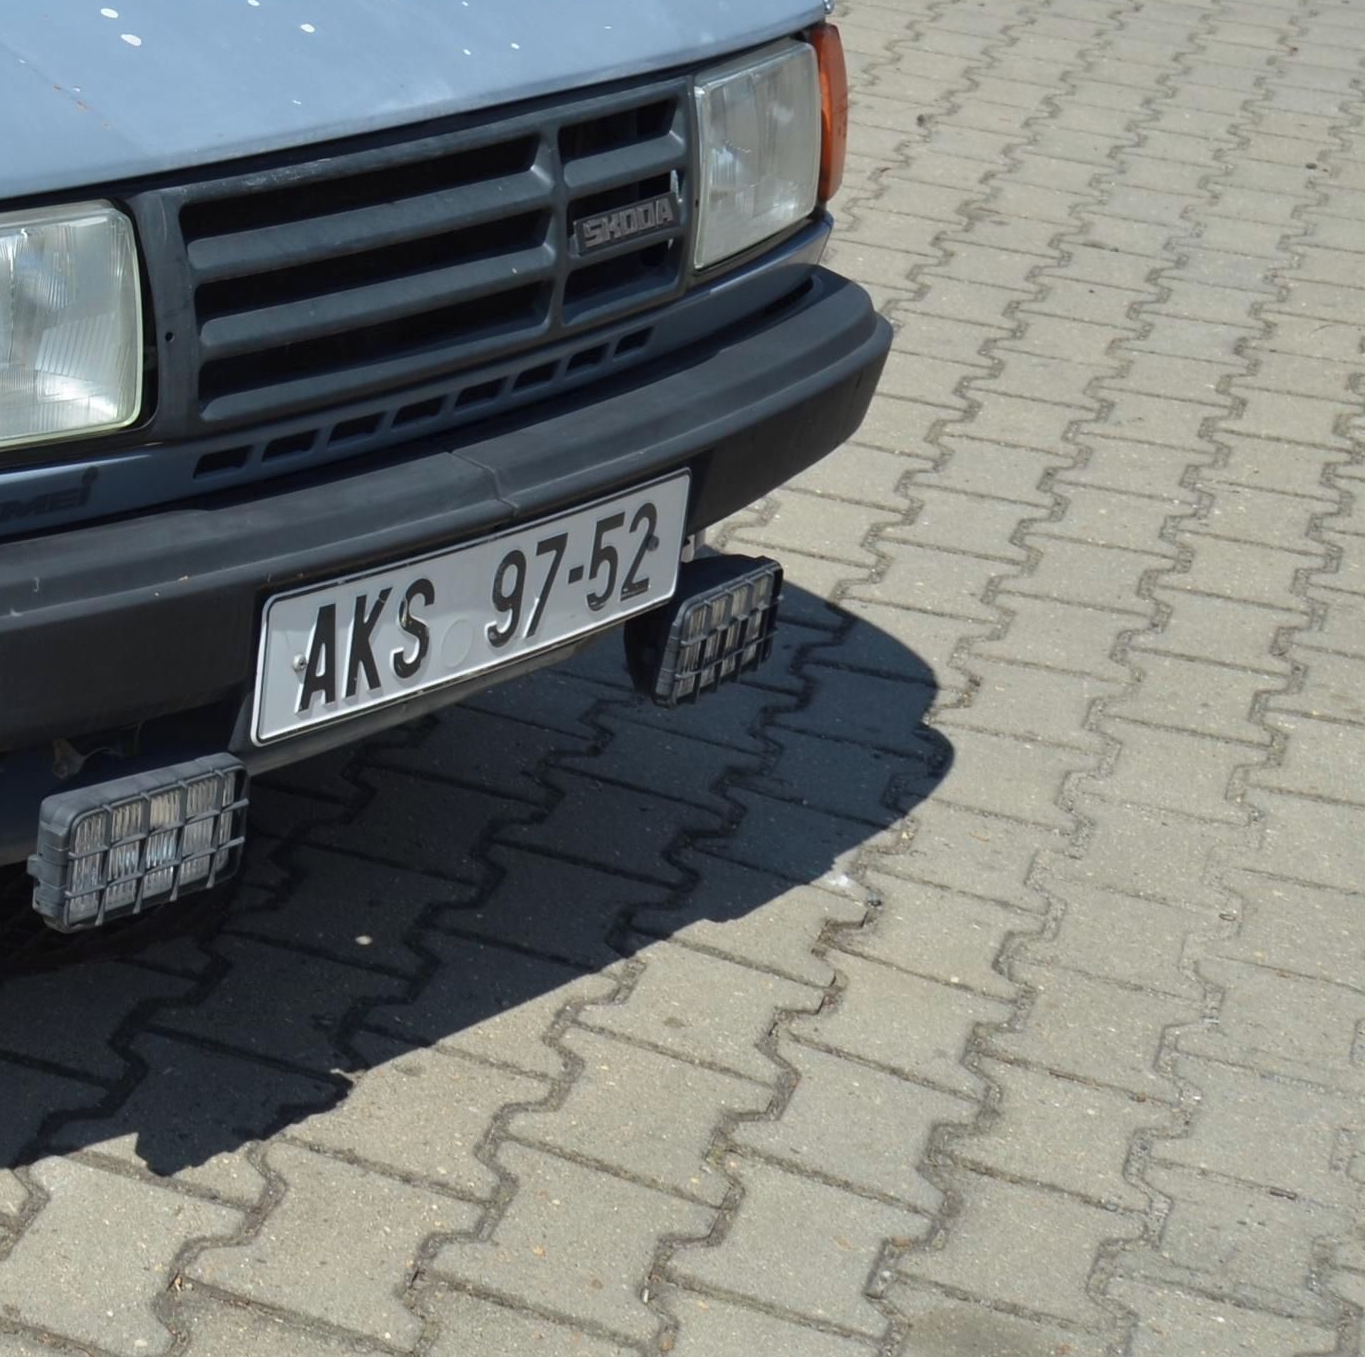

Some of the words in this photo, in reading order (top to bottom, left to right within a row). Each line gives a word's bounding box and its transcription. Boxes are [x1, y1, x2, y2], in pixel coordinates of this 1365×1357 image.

[582, 197, 674, 248] SKODA
[295, 577, 435, 714] AKS
[485, 502, 658, 647] 97-52
